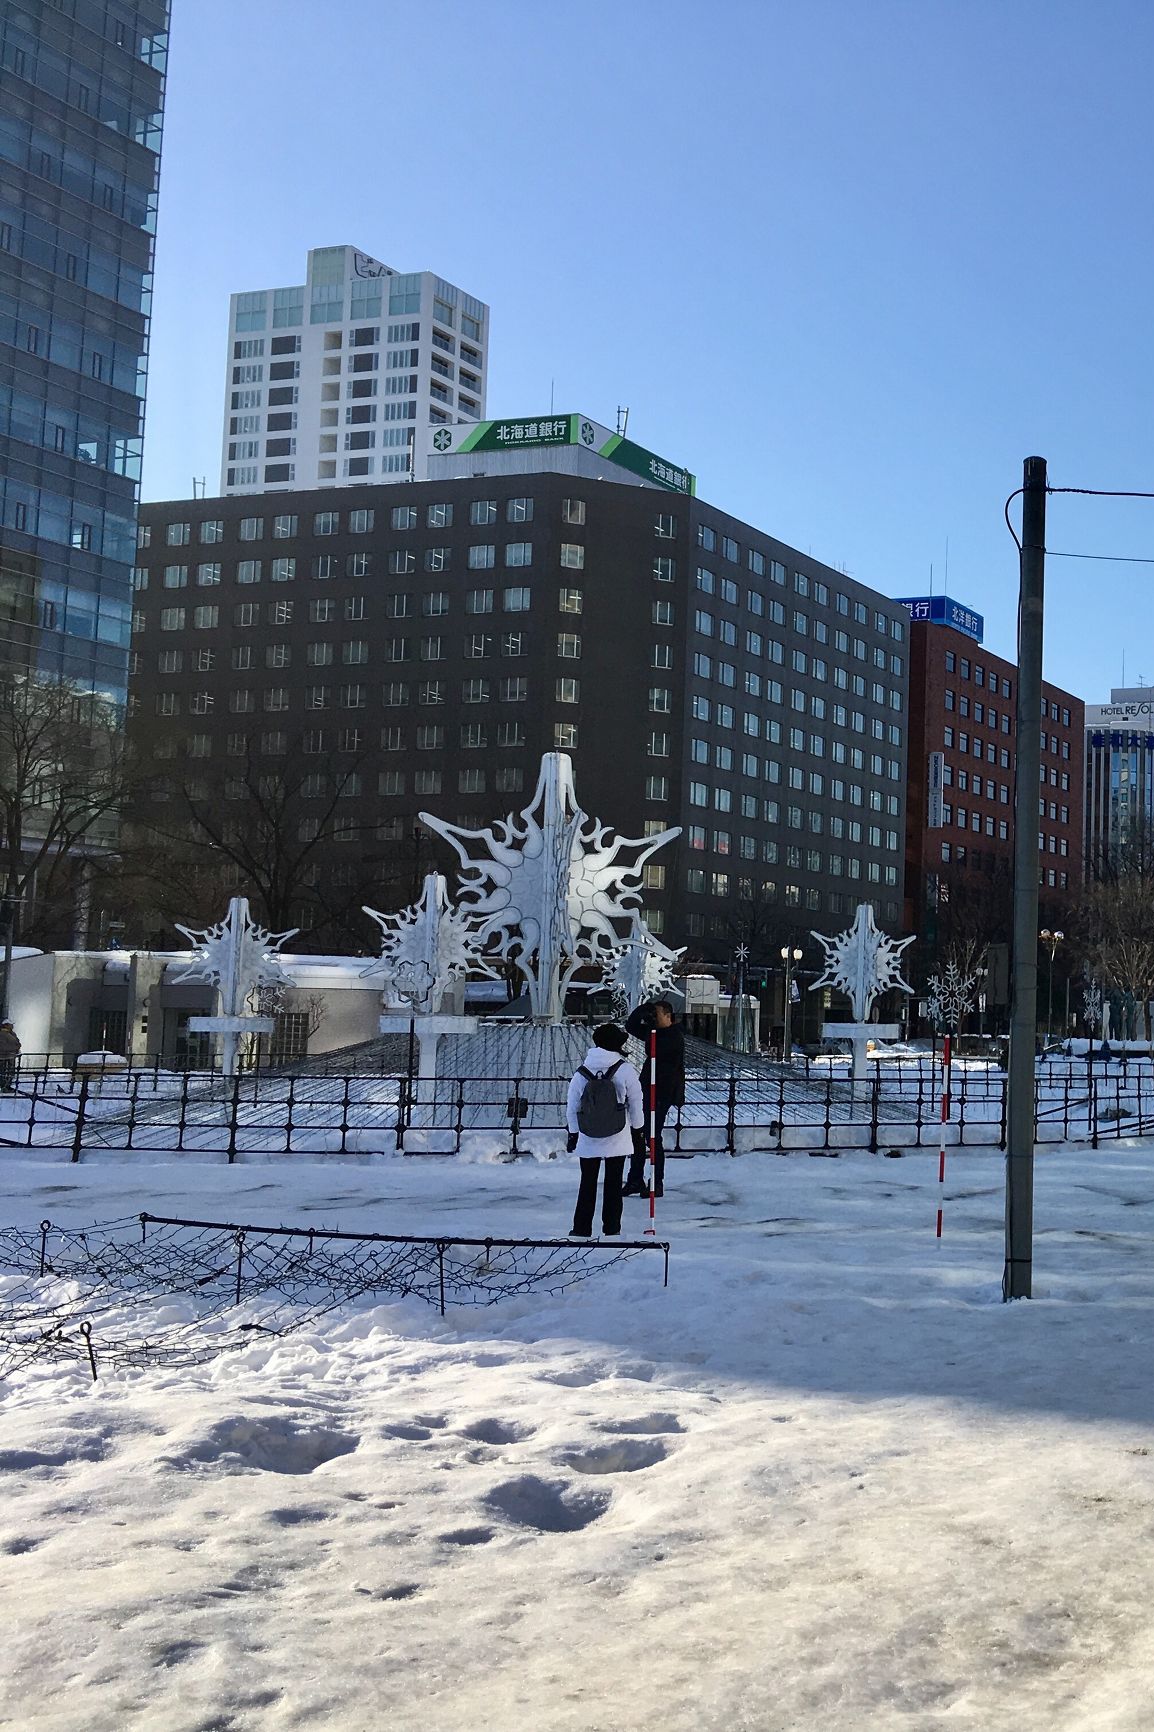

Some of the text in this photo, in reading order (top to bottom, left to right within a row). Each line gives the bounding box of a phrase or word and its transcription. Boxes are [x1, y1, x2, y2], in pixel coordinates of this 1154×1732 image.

[496, 420, 567, 441] 北海道銀行
[952, 606, 978, 632] 北洋銀行
[1100, 707, 1124, 716] HOTEL
